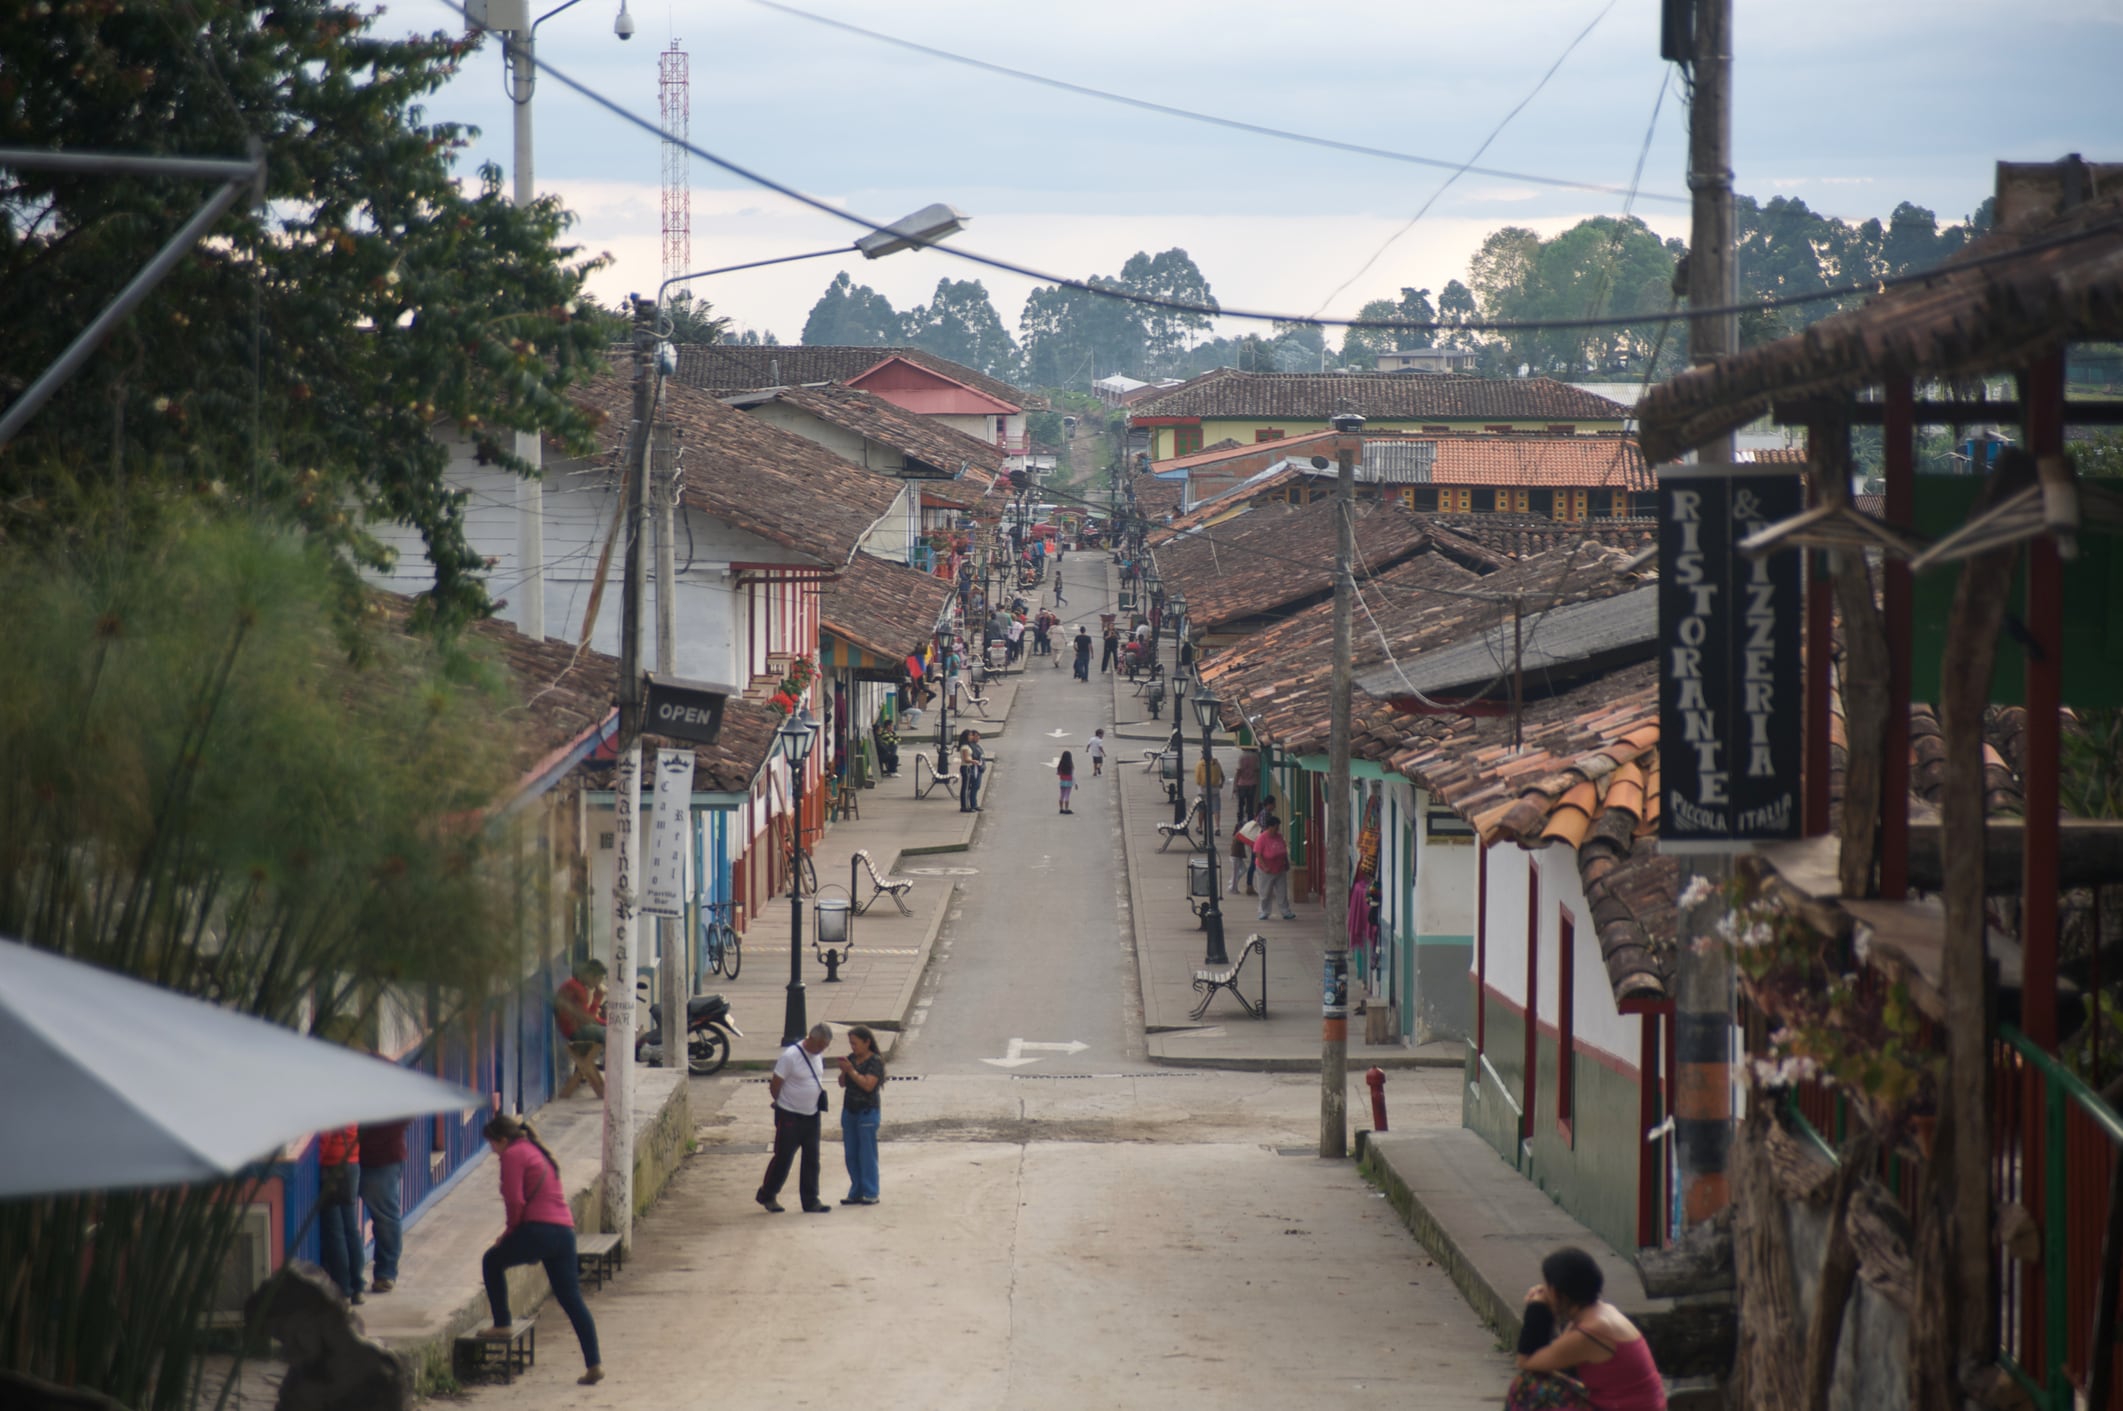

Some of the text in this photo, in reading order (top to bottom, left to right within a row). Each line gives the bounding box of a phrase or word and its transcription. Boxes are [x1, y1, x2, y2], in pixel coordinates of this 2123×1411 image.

[1733, 489, 1764, 520] &
[1671, 489, 1729, 805] RISTORANTE
[659, 703, 711, 725] OPEN
[652, 780, 670, 885] Camino
[671, 809, 684, 880] Real
[1670, 789, 1793, 832] PICCOLA ITALIA
[615, 776, 633, 984] Camino Real
